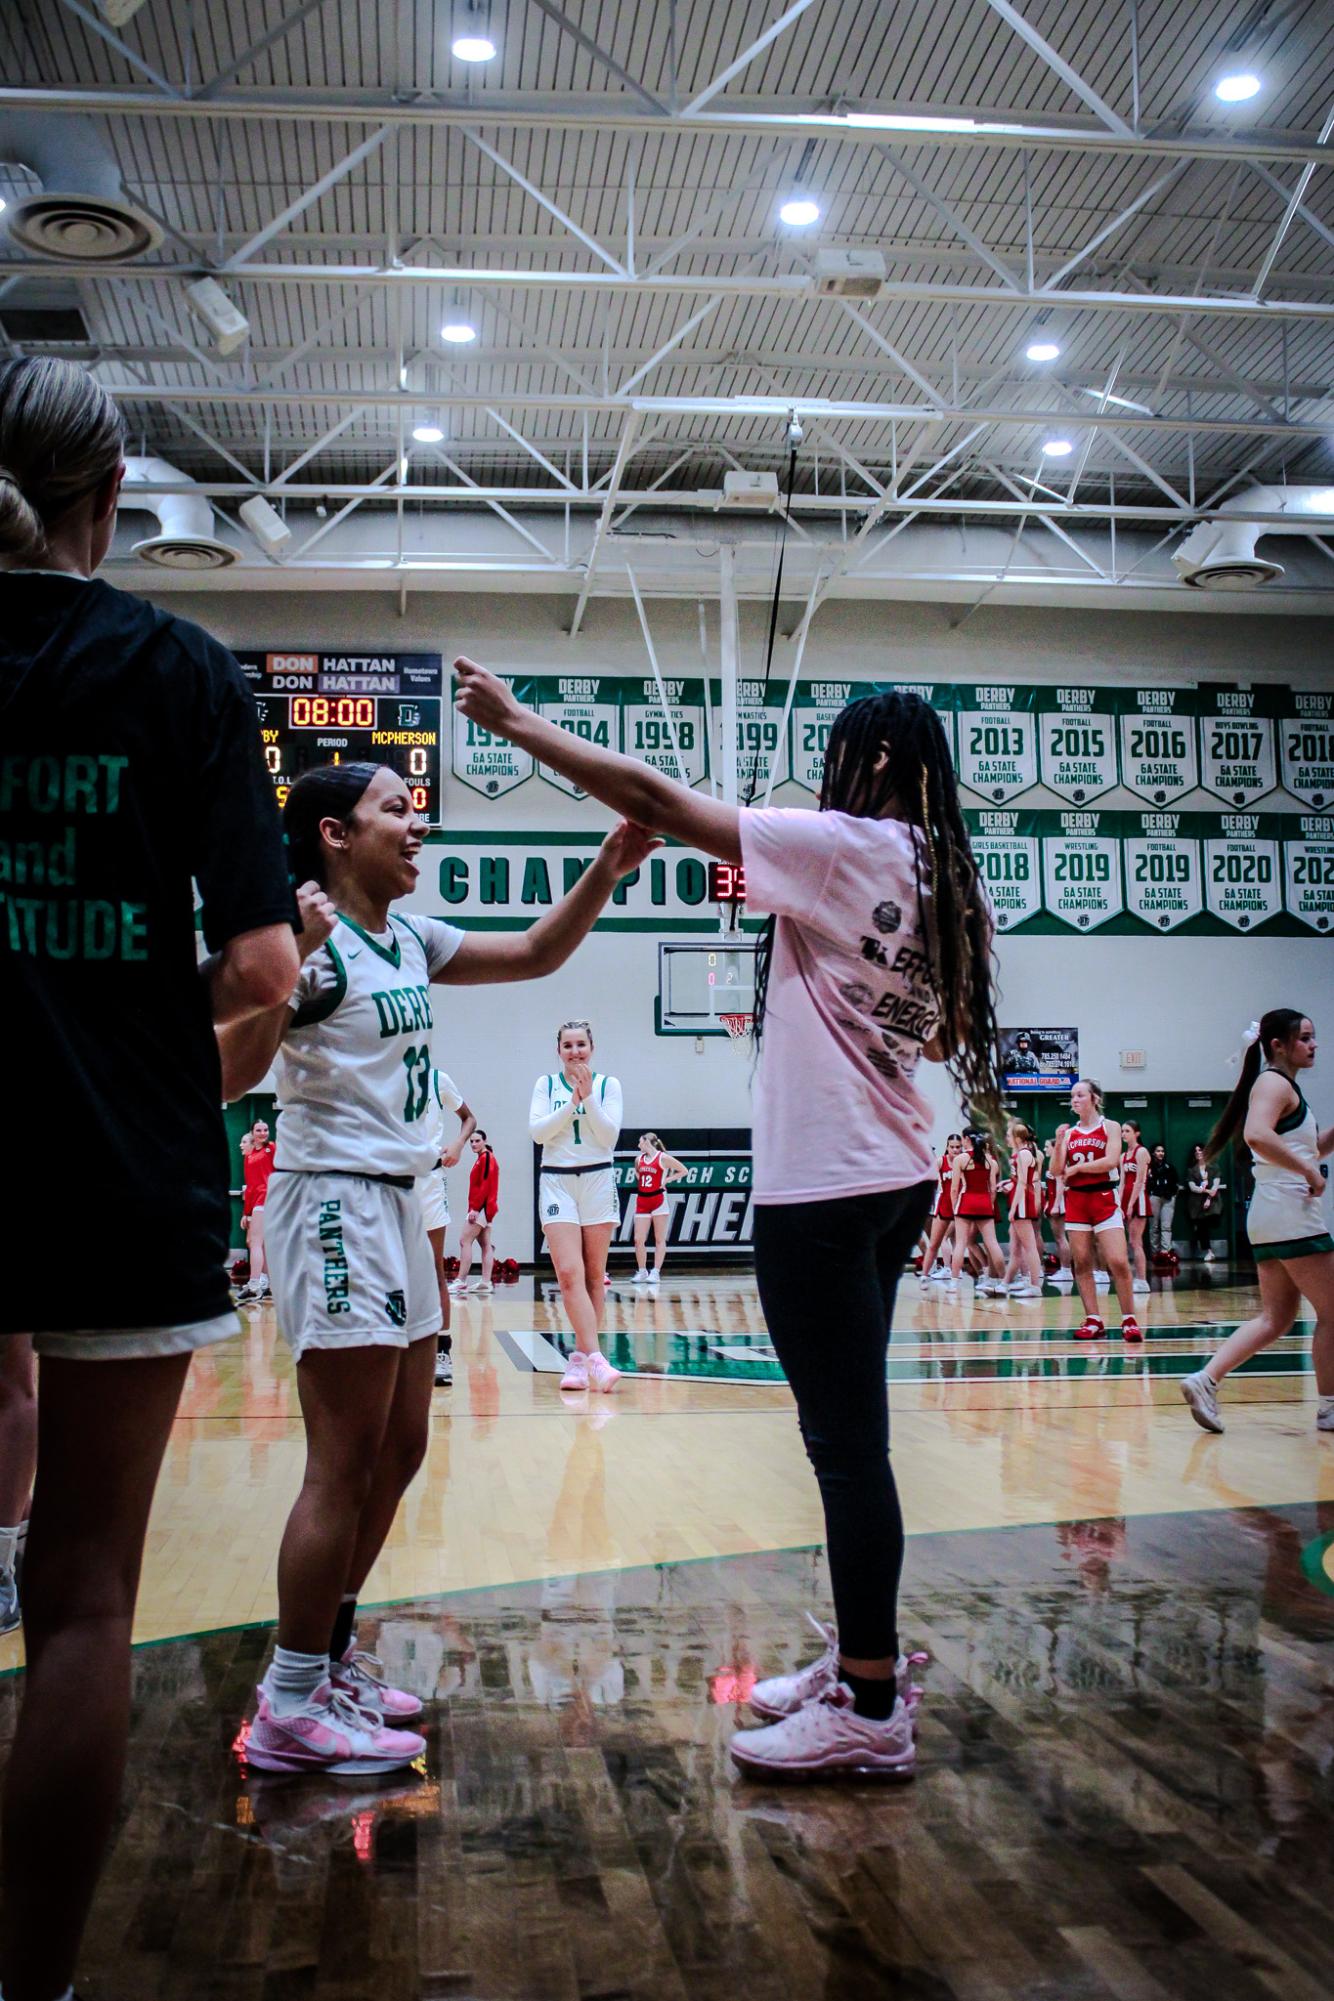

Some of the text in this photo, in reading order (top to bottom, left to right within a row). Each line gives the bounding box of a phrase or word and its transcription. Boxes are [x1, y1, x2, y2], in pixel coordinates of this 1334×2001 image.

[273, 657, 314, 670] DON
[323, 658, 395, 673] HATTAN
[272, 676, 313, 689] DON
[322, 676, 395, 690] HATTAN
[559, 678, 600, 694] DERBY
[736, 681, 767, 697] ERBY
[811, 684, 851, 698] DERBY
[975, 687, 1015, 703] DERBY
[1056, 689, 1096, 704] DERBY
[648, 696, 680, 704] PANHERS
[1137, 691, 1176, 706] DERBY
[1216, 693, 1255, 708] DERBY
[1295, 695, 1333, 710] DERBY
[294, 698, 373, 726] 08:00
[564, 709, 595, 717] FOOTBALL
[980, 702, 1011, 711] PANTHERS
[1061, 703, 1092, 712] PANTHERS
[981, 717, 1011, 725] FOOTBALL
[1062, 718, 1092, 727] FOOTBALL
[1143, 719, 1172, 728] FOOTBALL
[317, 738, 347, 747] PERIOD
[371, 731, 436, 745] MCPHERSON
[803, 723, 831, 751] 20
[970, 727, 1024, 756] 2013
[1051, 729, 1105, 757] 2015
[1130, 730, 1186, 758] 2016
[1211, 732, 1264, 761] 2017
[410, 748, 427, 775] 0
[473, 752, 513, 764] 6A STATE
[466, 764, 519, 776] CHAMPIONS
[978, 760, 1016, 771] 6A STATE
[1059, 762, 1097, 773] 6A STATE
[1140, 763, 1178, 774] 6A STATE
[1220, 765, 1257, 776] 6A STATE
[404, 777, 431, 787] FOULS
[972, 772, 1023, 784] CHAMPIONS
[1053, 773, 1103, 785] CHAMPIONS
[1135, 775, 1185, 787] CHAMPIONS
[1215, 777, 1263, 788] CHAMPIONS
[413, 787, 426, 809] 0
[979, 812, 1019, 827] DERBY
[1060, 813, 1100, 828] DERBY
[1141, 814, 1180, 829] DERBY
[1220, 815, 1260, 830] DERBY
[984, 827, 1015, 836] PANTHERS
[1066, 828, 1096, 836] PANTHERS
[991, 841, 1028, 850] BASKETBALL
[1065, 842, 1099, 850] WRESTLING
[1147, 843, 1176, 851] FOOTBALL
[1227, 844, 1256, 852] FOOTBALL
[973, 853, 1029, 881] 2018
[1054, 853, 1110, 881] 2019
[1135, 854, 1190, 882] 2019
[1213, 855, 1272, 883] 2020
[1293, 857, 1334, 885] 202
[439, 856, 708, 906] CHAPIO
[996, 887, 1020, 898] STATE
[1063, 887, 1102, 898] 6A STATE
[1144, 887, 1182, 899] 6A STATE
[1224, 888, 1261, 899] 6A STATE
[1317, 890, 1334, 901] STAT
[993, 898, 1027, 910] MPIONS
[1058, 898, 1108, 910] CHAMPIONS
[1139, 899, 1188, 911] CHAMPIONS
[1219, 900, 1268, 911] CHAMPIONS
[0, 892, 149, 961] ITUDE
[403, 1044, 431, 1123] 13
[572, 1119, 582, 1145] 1
[641, 1174, 653, 1187] 12
[724, 1166, 750, 1184] SC
[320, 1199, 351, 1316] PANTHERS
